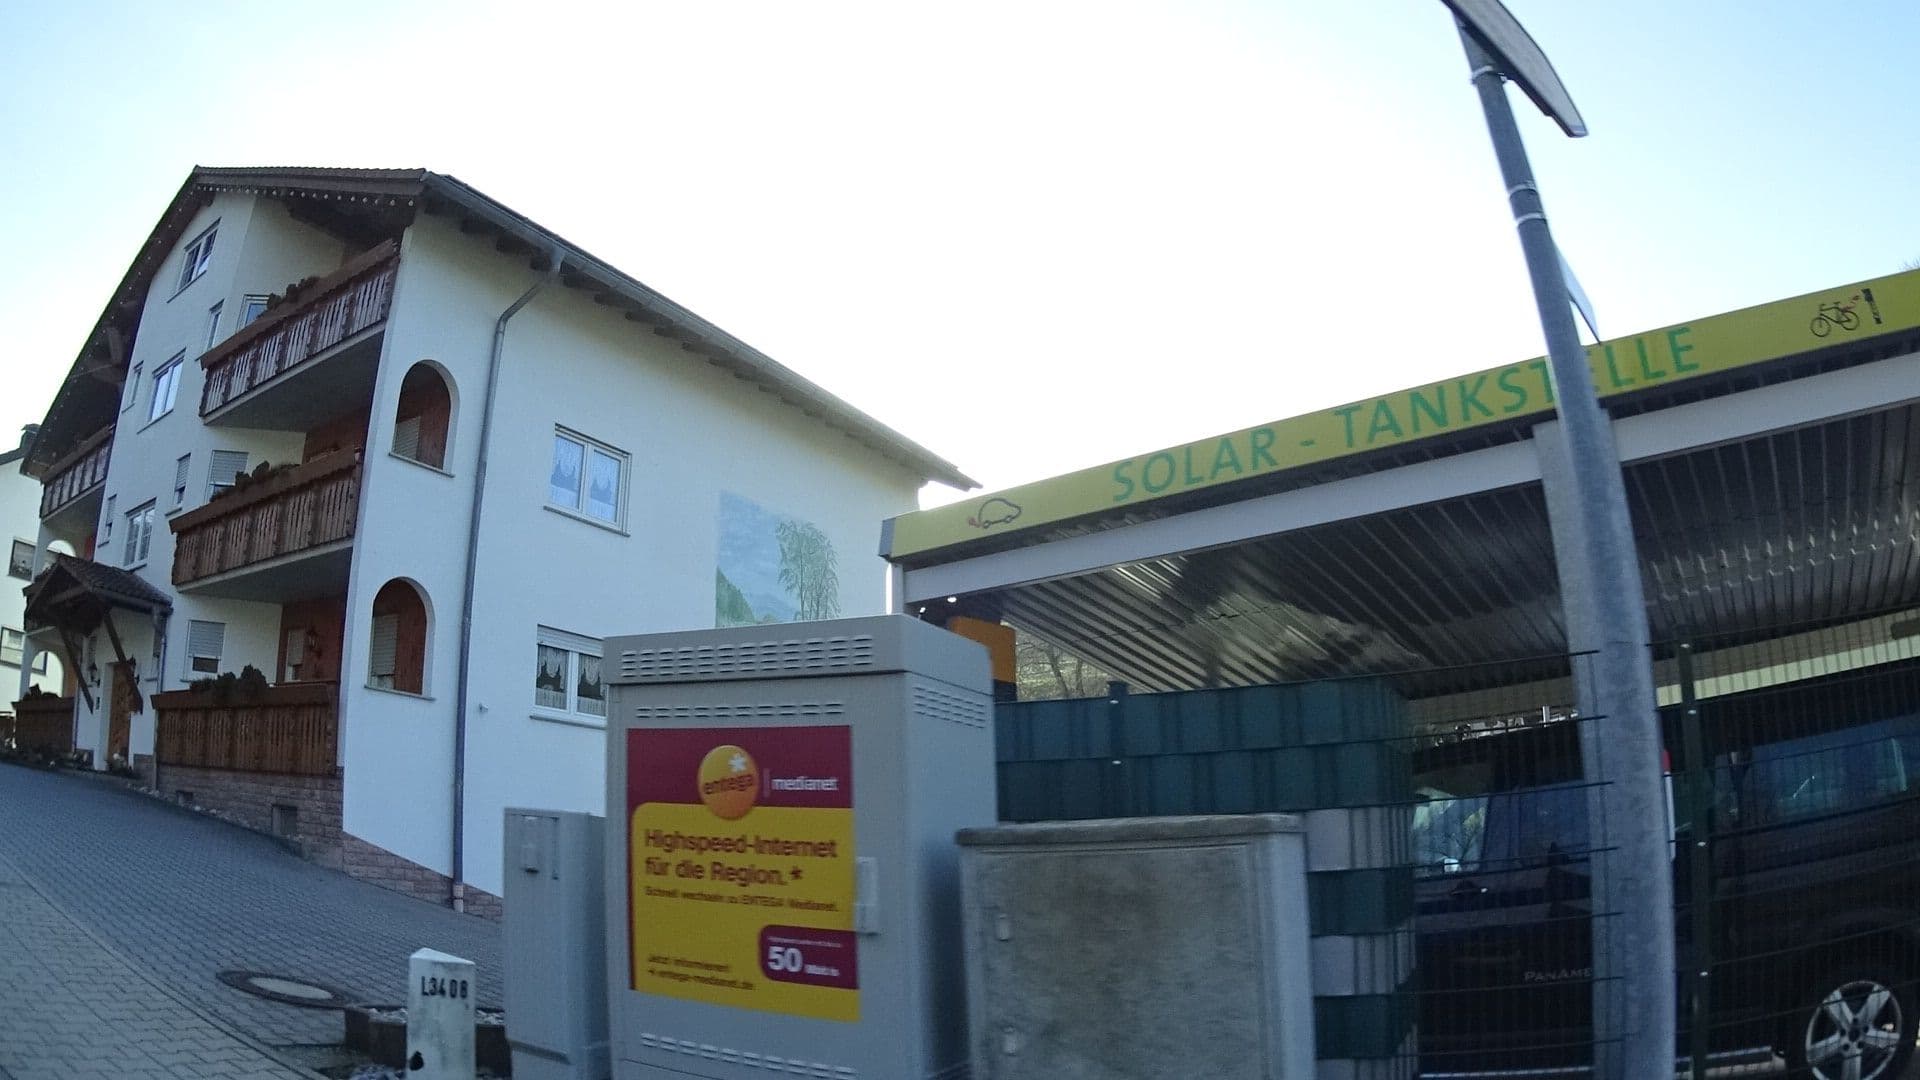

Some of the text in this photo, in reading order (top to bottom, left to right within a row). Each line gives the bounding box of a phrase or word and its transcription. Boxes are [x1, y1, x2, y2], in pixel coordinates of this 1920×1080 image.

[1112, 427, 1280, 503] SOLAR
[1333, 326, 1700, 450] TANKSTLLE
[645, 829, 838, 858] Highspeed-Internet
[645, 856, 672, 877] für
[675, 860, 705, 879] die
[767, 946, 804, 973] 50
[421, 975, 469, 999] L3408
